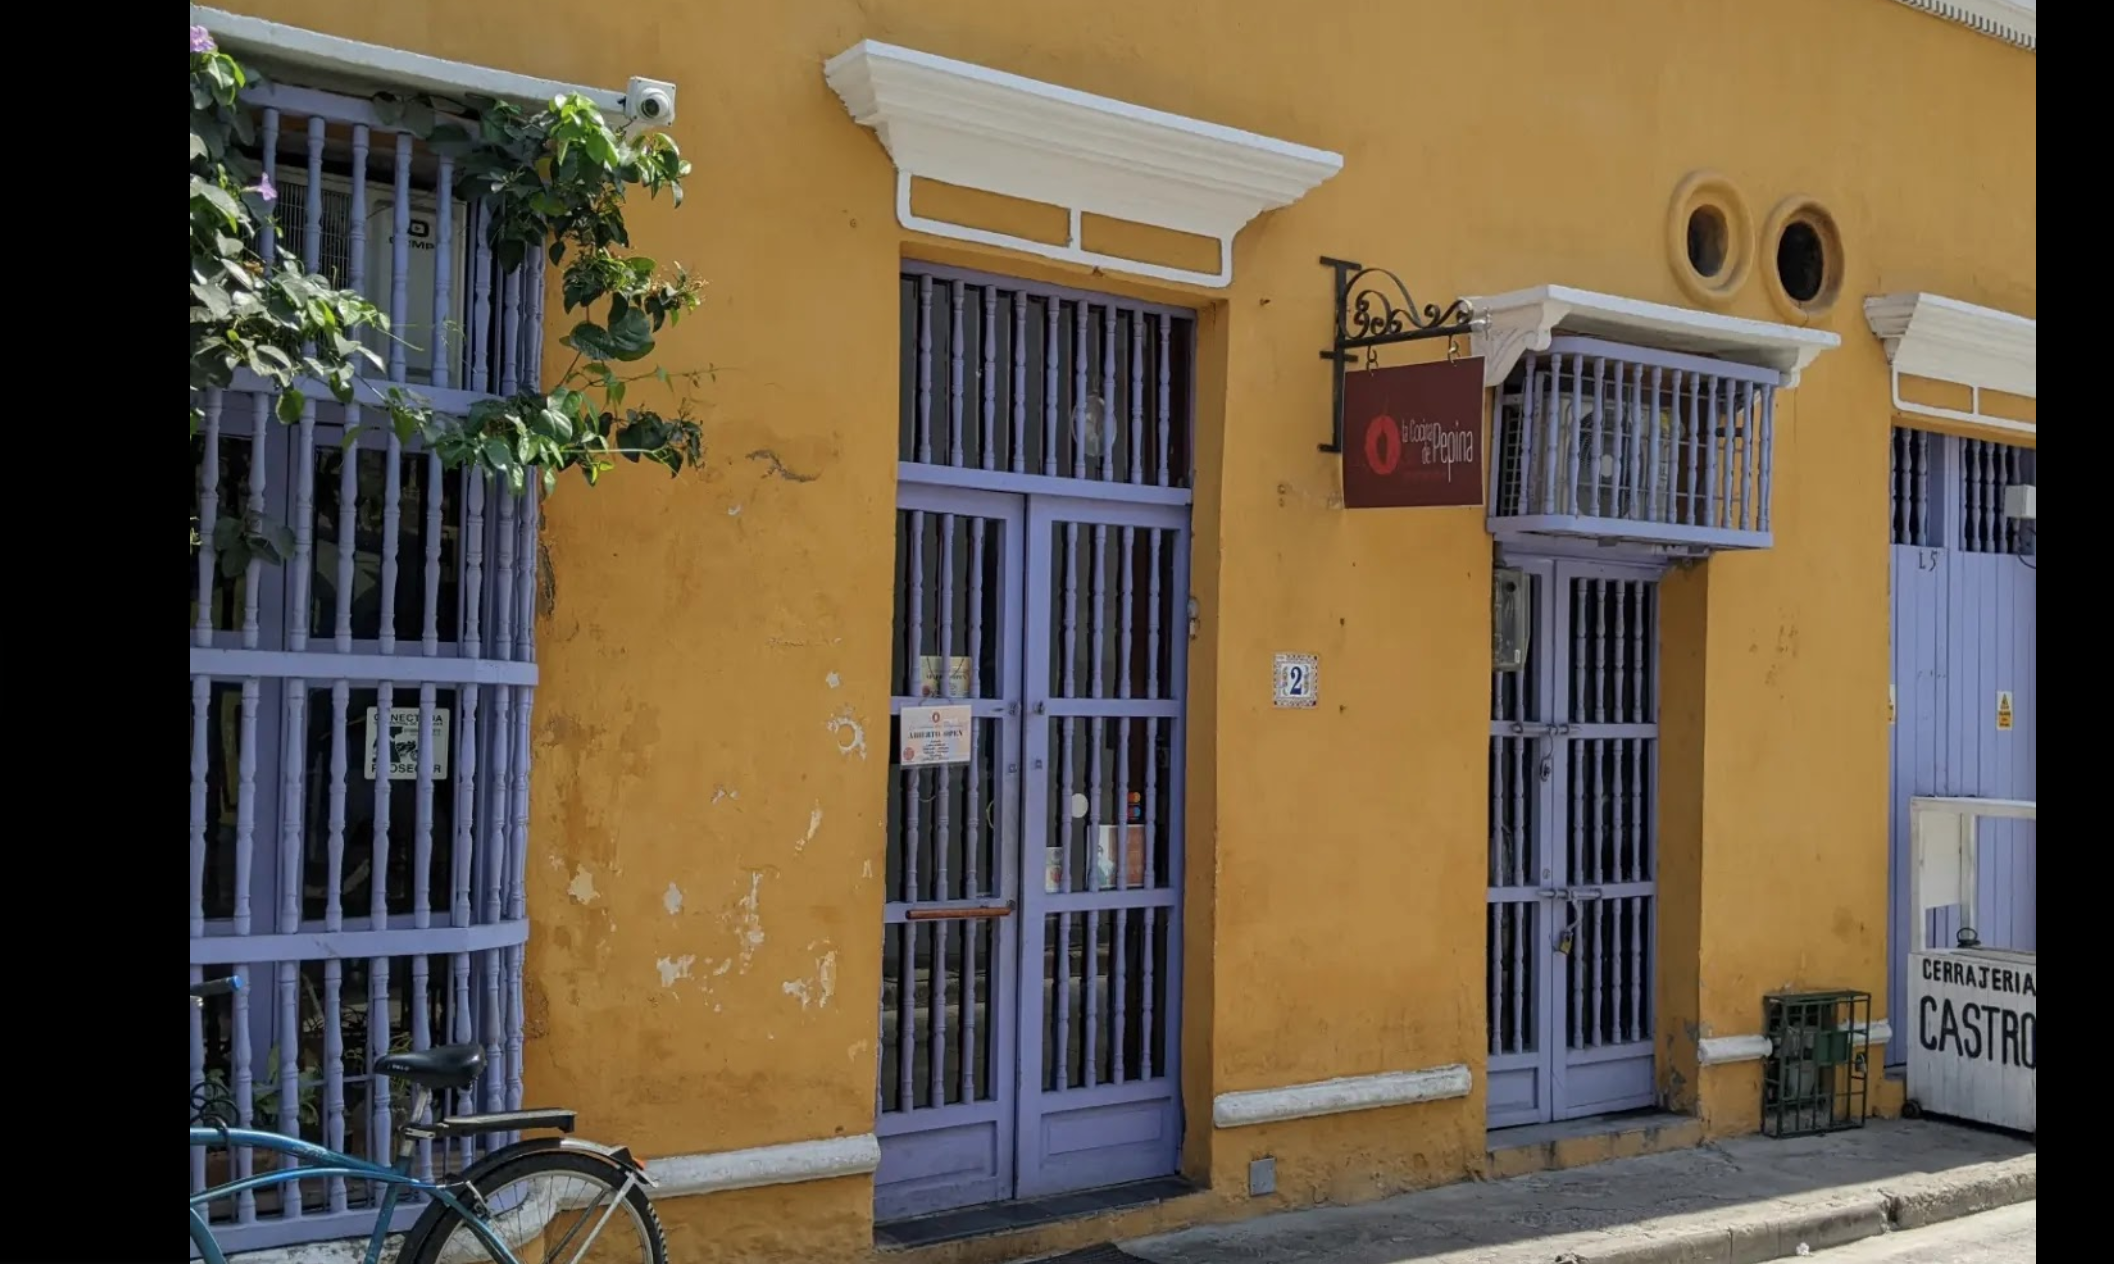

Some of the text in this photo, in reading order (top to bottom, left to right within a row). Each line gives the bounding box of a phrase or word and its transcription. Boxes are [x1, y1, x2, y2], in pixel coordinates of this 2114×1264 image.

[1409, 419, 1433, 442] Cocina
[1421, 420, 1473, 482] de Pepina
[1290, 666, 1302, 695] 2
[907, 729, 963, 739] ABIERTO OPEN
[1922, 958, 2036, 996] CERRAJERIA
[1920, 995, 2036, 1070] CASTRO
